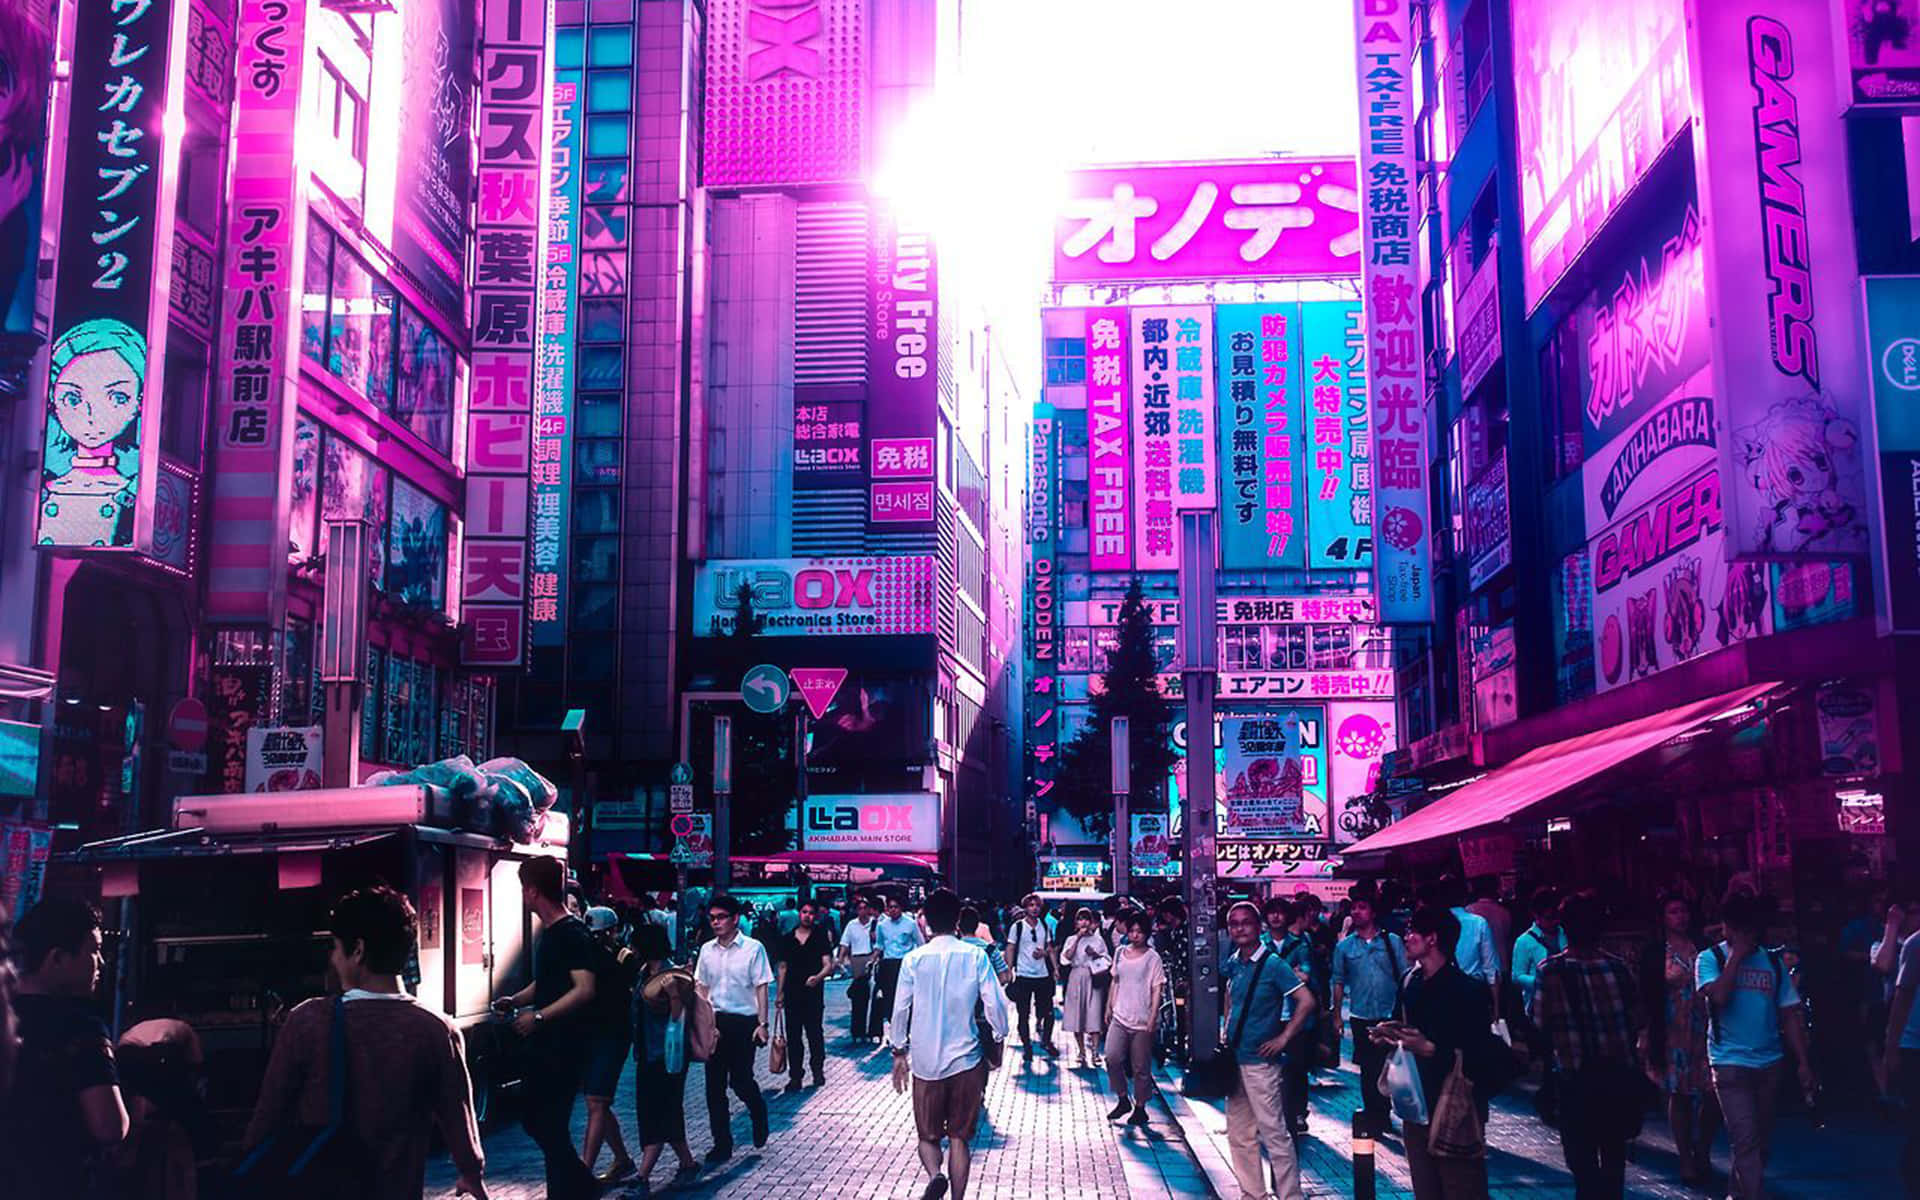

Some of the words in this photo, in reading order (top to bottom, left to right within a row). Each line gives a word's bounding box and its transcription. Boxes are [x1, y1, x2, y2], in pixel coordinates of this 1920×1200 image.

[1366, 53, 1405, 155] TAX-FREE
[1369, 161, 1412, 266] 免税商店
[1746, 15, 1820, 394] GAMERS
[548, 246, 569, 262] 5F
[892, 234, 931, 292] uty
[229, 208, 280, 444] アキバ駅前店
[875, 290, 892, 341] Store
[895, 300, 933, 379] Free
[1091, 318, 1122, 386] 免税
[1902, 345, 1916, 384] DELL
[539, 420, 562, 433] 4F
[795, 405, 828, 422] 本店
[795, 422, 861, 440] 総合家電
[1094, 391, 1123, 460] TAX
[1230, 331, 1258, 524] お見積り無料です
[877, 445, 929, 470] 免税
[1611, 401, 1709, 503] AKIHABARA
[875, 491, 930, 512] 면세점
[1032, 417, 1052, 543] Panasonic
[1095, 467, 1126, 557] FREE
[1597, 470, 1723, 593] GAMER
[757, 614, 832, 628] lectronics
[836, 612, 876, 626] Store
[1035, 558, 1053, 660] ONODEN
[1234, 602, 1294, 621] 免税店
[803, 679, 836, 690] 止まれ
[1230, 677, 1304, 693] エアコン
[809, 834, 858, 842] AKIHABARA
[860, 834, 882, 842] MAIN
[884, 834, 912, 842] STORE
[1215, 845, 1322, 860] レビはオノデンで!
[1225, 860, 1301, 874] ノデン
[752, 901, 776, 912] GA
